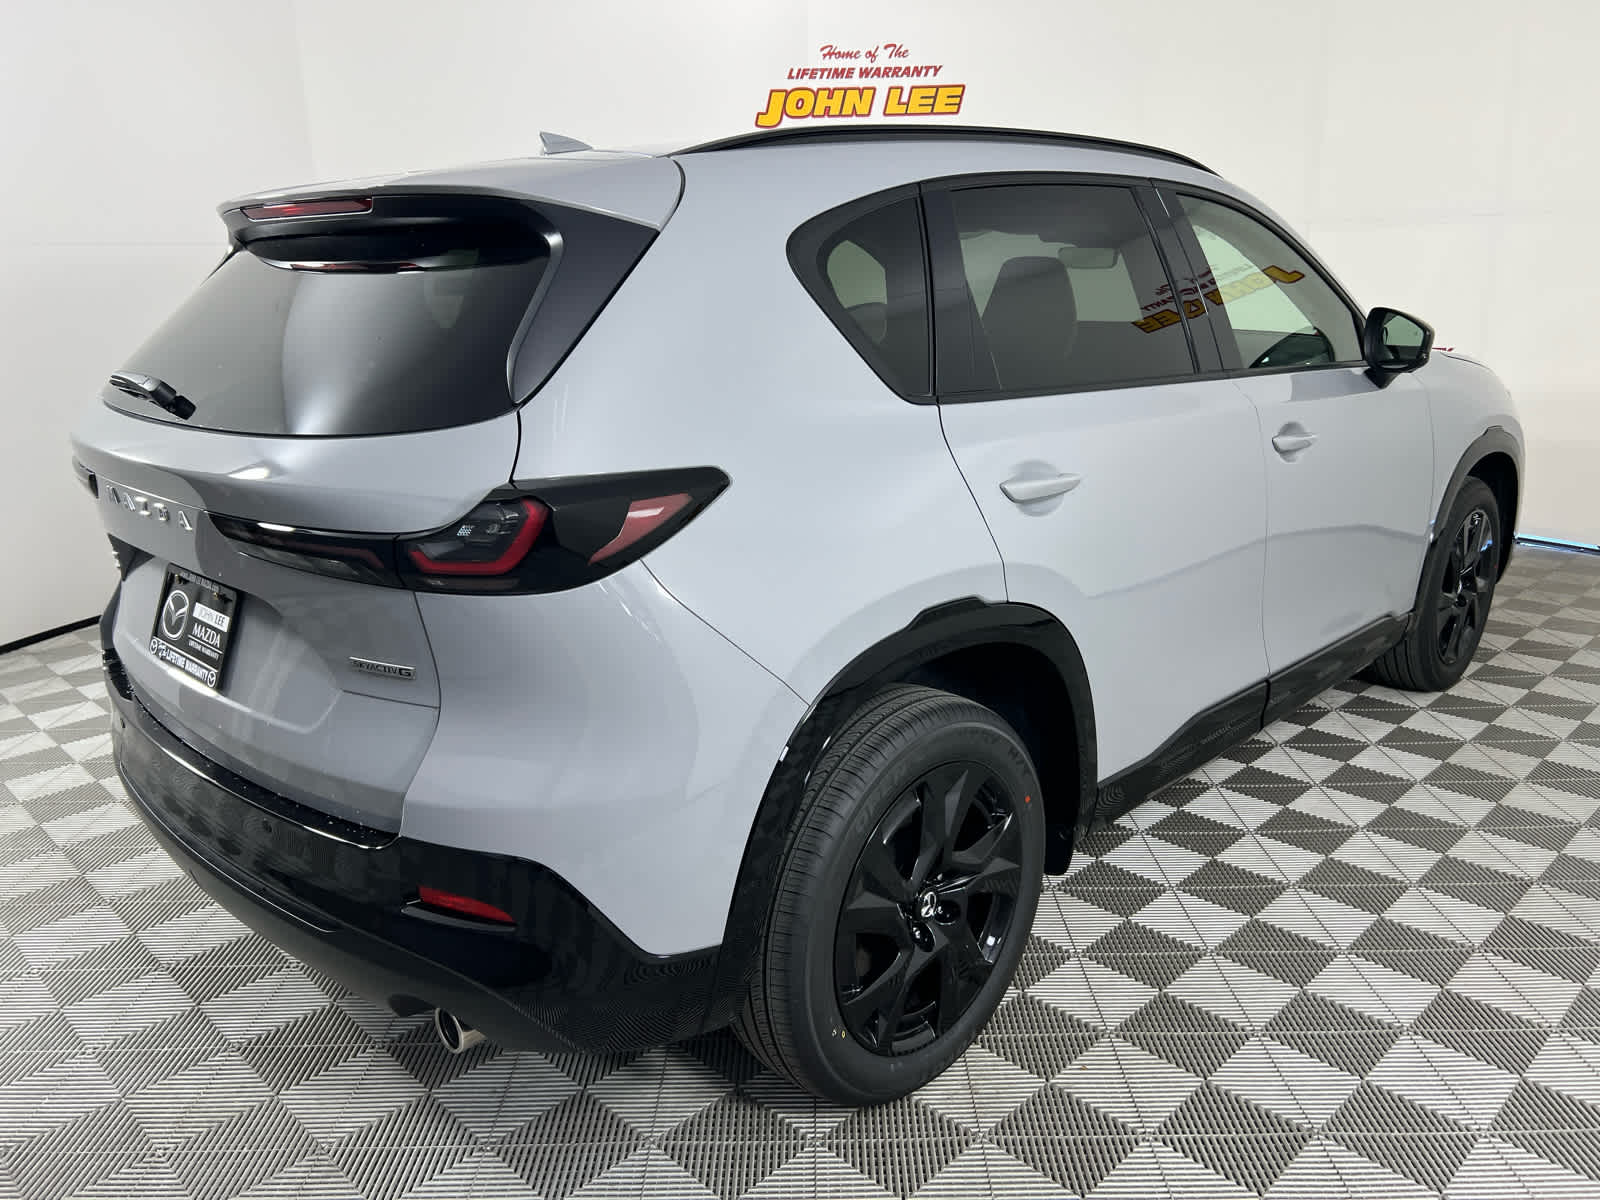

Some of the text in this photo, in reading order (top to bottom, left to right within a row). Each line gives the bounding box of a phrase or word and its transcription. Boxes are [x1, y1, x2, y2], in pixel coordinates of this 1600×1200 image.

[820, 43, 909, 63] Home of The
[787, 65, 943, 80] LIFETIME WARRANTY
[755, 84, 965, 129] JOHN LEE
[214, 613, 226, 627] LEE
[191, 622, 220, 649] MAZDA
[165, 648, 186, 669] LIFETIME
[184, 659, 209, 681] WARRANTY
